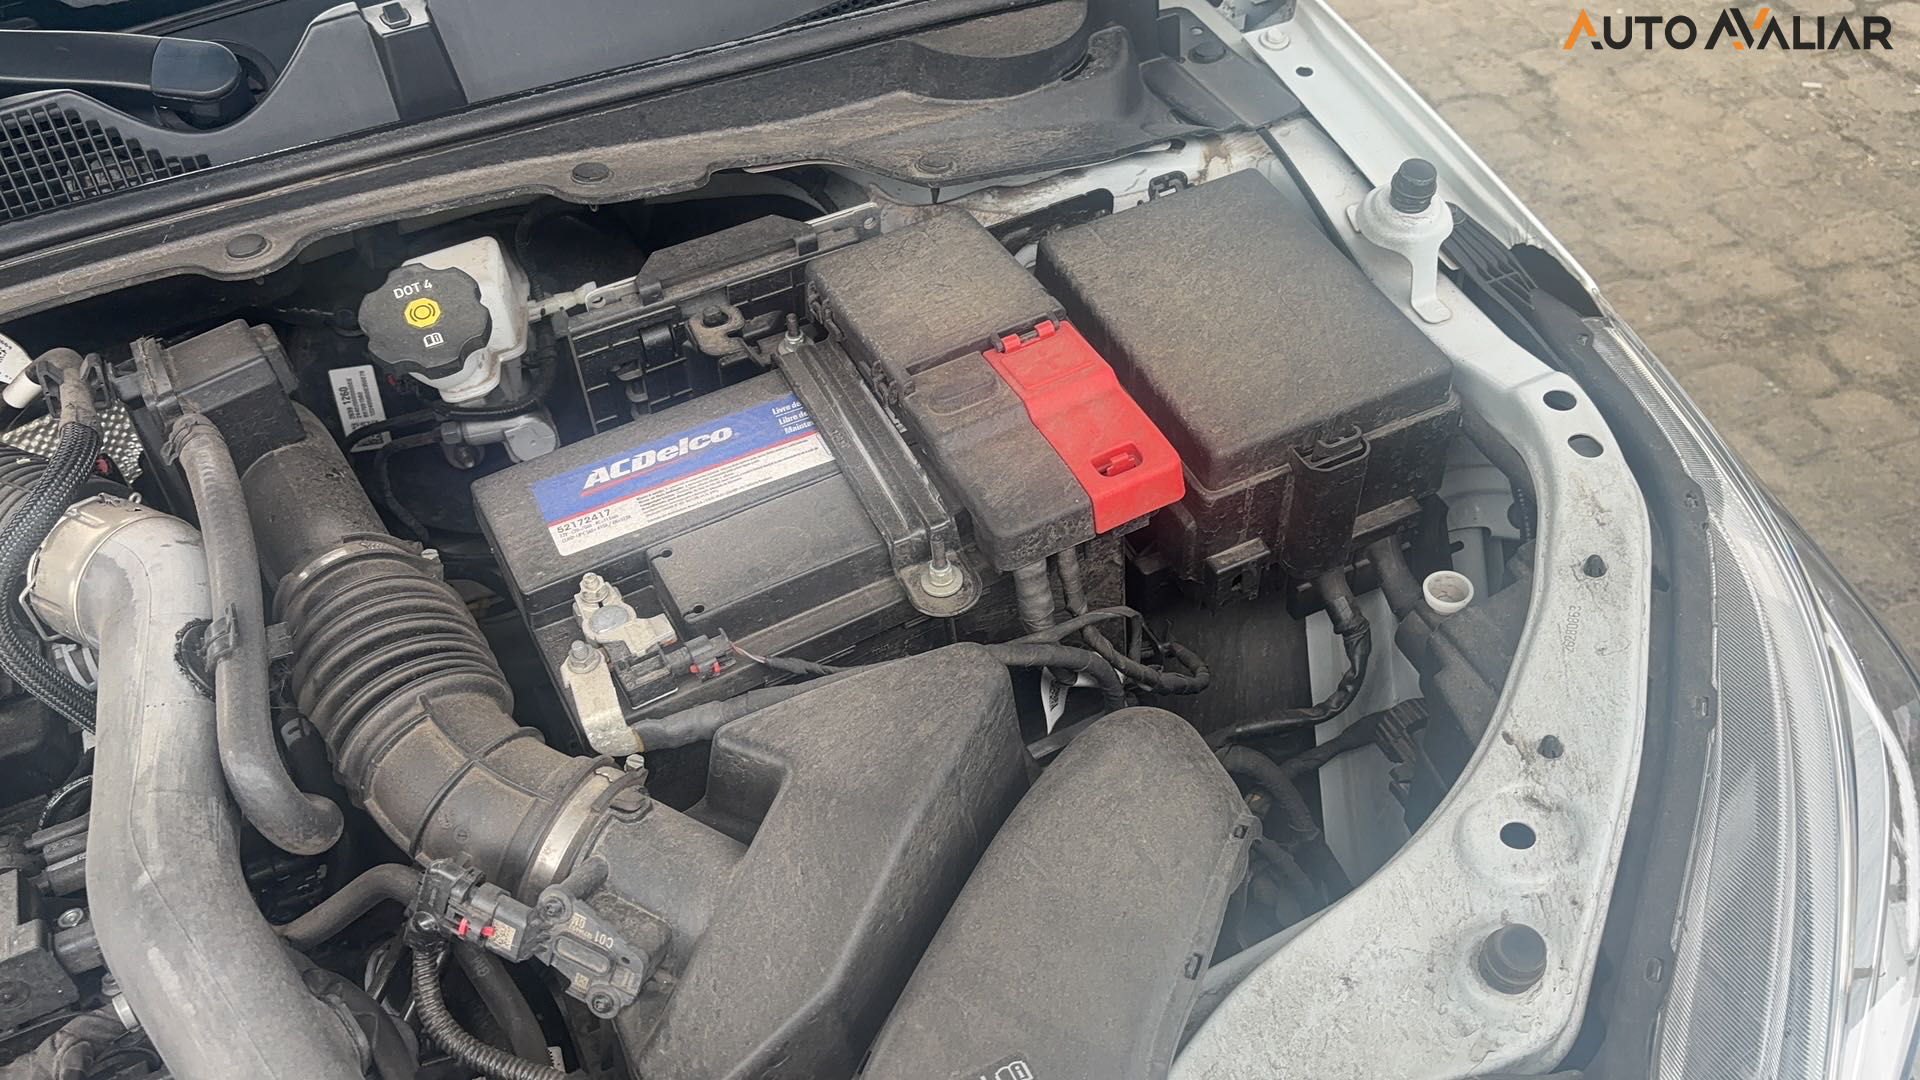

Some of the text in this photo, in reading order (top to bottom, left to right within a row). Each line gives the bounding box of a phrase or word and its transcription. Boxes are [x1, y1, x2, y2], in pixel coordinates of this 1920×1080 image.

[393, 279, 433, 300] DOT 4
[338, 386, 351, 405] 1260
[771, 401, 802, 415] Livre de
[778, 414, 798, 425] Libre
[784, 421, 815, 434] Mainte
[582, 427, 733, 489] ACDelco
[557, 509, 610, 533] 52172417
